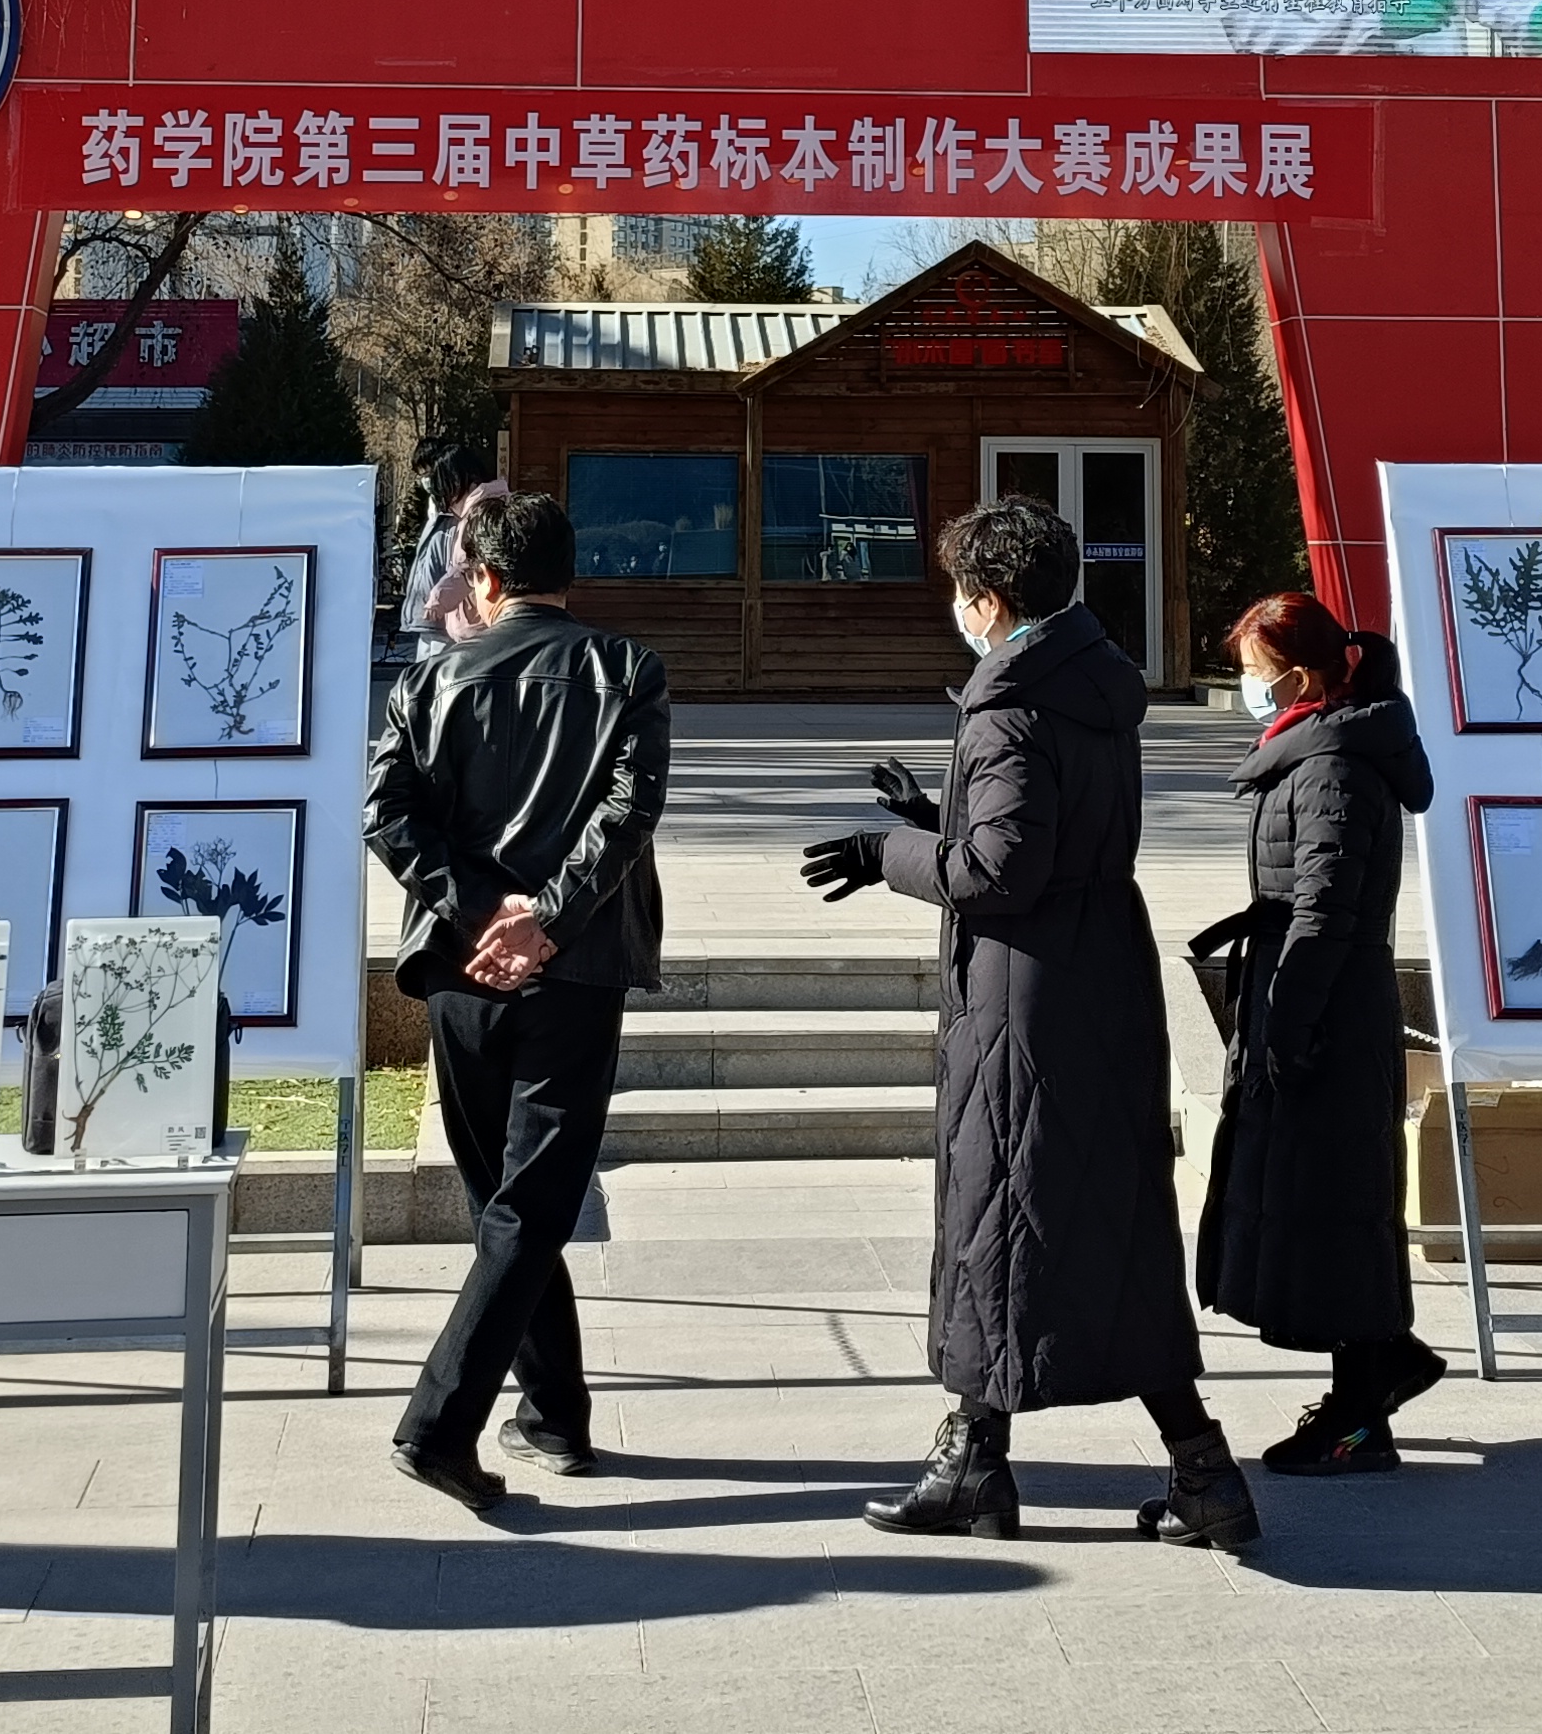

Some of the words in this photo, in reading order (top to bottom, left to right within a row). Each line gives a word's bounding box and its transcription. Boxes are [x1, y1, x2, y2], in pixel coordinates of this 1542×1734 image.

[81, 109, 1316, 201] 药学院第三届中草药标本制作大赛成果展
